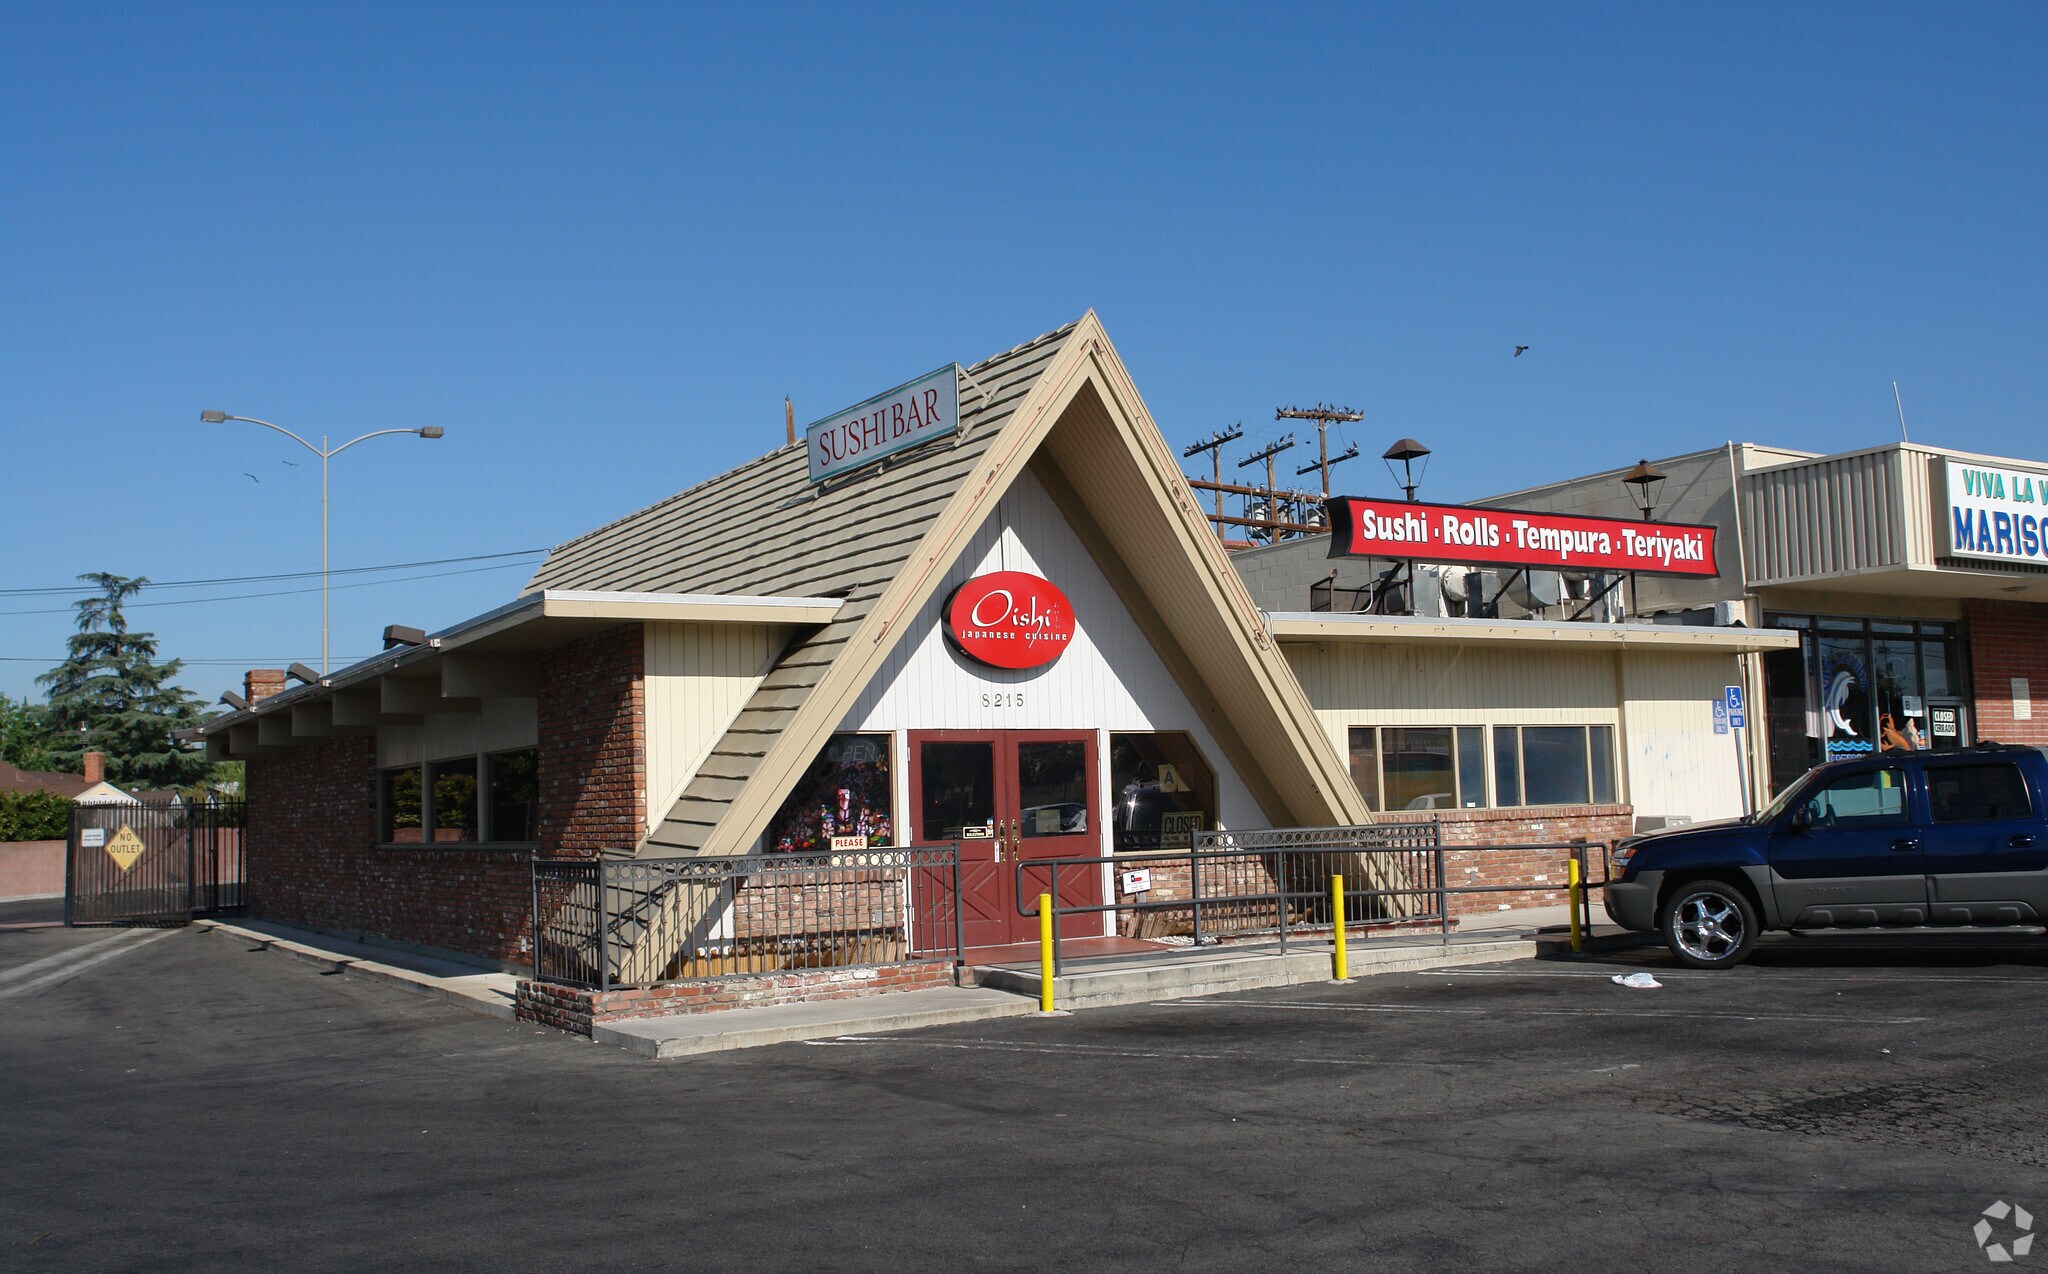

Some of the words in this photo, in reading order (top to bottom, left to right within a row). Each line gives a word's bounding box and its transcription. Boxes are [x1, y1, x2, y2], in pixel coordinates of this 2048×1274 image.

[819, 408, 887, 466] SUSHI
[891, 388, 941, 440] BAR
[1962, 468, 2006, 500] VIVA
[2012, 476, 2035, 503] LA
[1362, 508, 1429, 543] Sushi
[1443, 514, 1500, 548] Rolls
[1512, 520, 1612, 560] Tempura
[1621, 528, 1704, 567] Teriyaki
[971, 589, 1051, 649] Oishi
[961, 629, 1016, 640] japanese
[1025, 631, 1067, 641] cuisine
[982, 693, 1024, 708] 8215
[1934, 711, 1954, 722] CLOSED
[1164, 770, 1174, 784] A
[120, 833, 132, 841] NO
[835, 838, 864, 847] PLEASE
[110, 844, 140, 854] OUTLET
